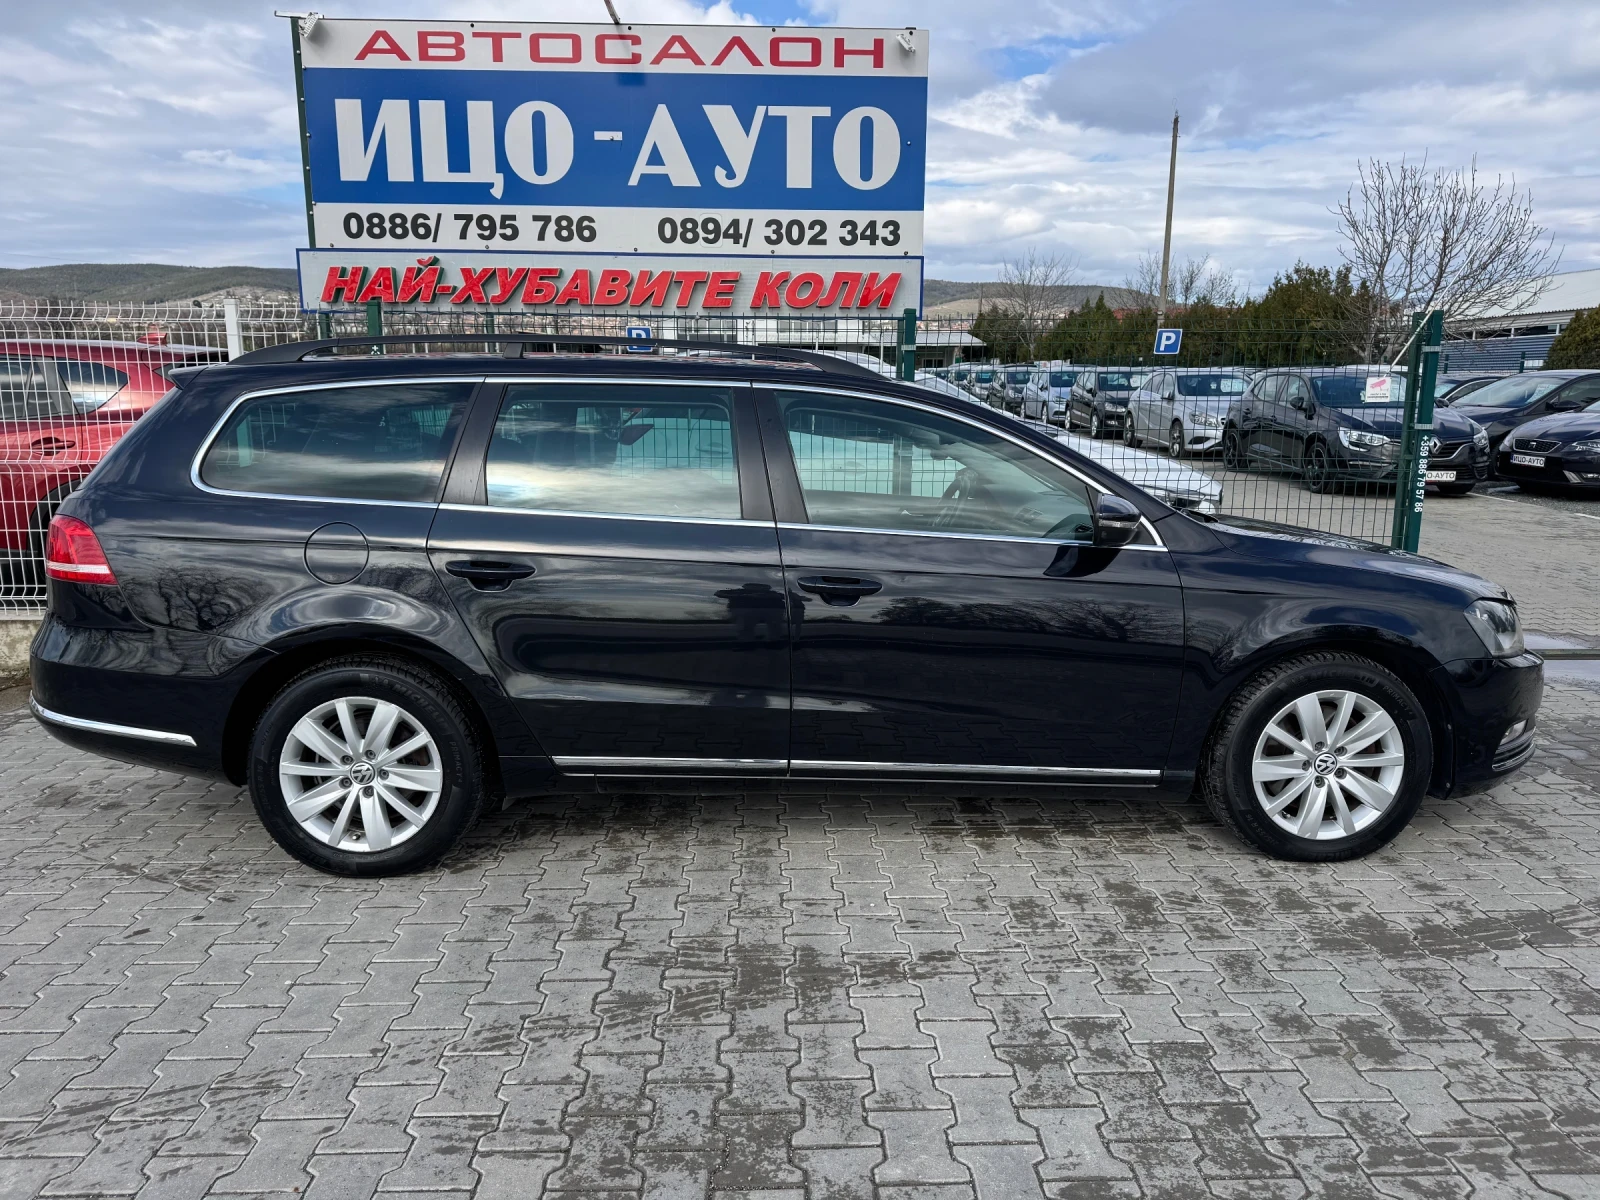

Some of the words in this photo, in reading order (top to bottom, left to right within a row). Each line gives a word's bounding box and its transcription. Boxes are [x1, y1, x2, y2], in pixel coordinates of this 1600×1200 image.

[354, 29, 886, 69] АВТОСАЛОН
[342, 212, 443, 241] 0886/
[453, 213, 520, 242] 795
[532, 215, 597, 243] 786
[657, 217, 754, 246] 0894/
[764, 219, 827, 246] 302
[838, 219, 901, 247] 343
[320, 256, 740, 310] НАЙ-ХУБАВИТЕ
[751, 270, 903, 310] КОЛИ
[631, 329, 647, 349] P
[1159, 332, 1176, 351] P
[1420, 435, 1430, 457] +359
[1418, 458, 1428, 475] 886
[1416, 477, 1426, 488] 79
[1415, 489, 1425, 500] 57
[1414, 502, 1424, 513] 86
